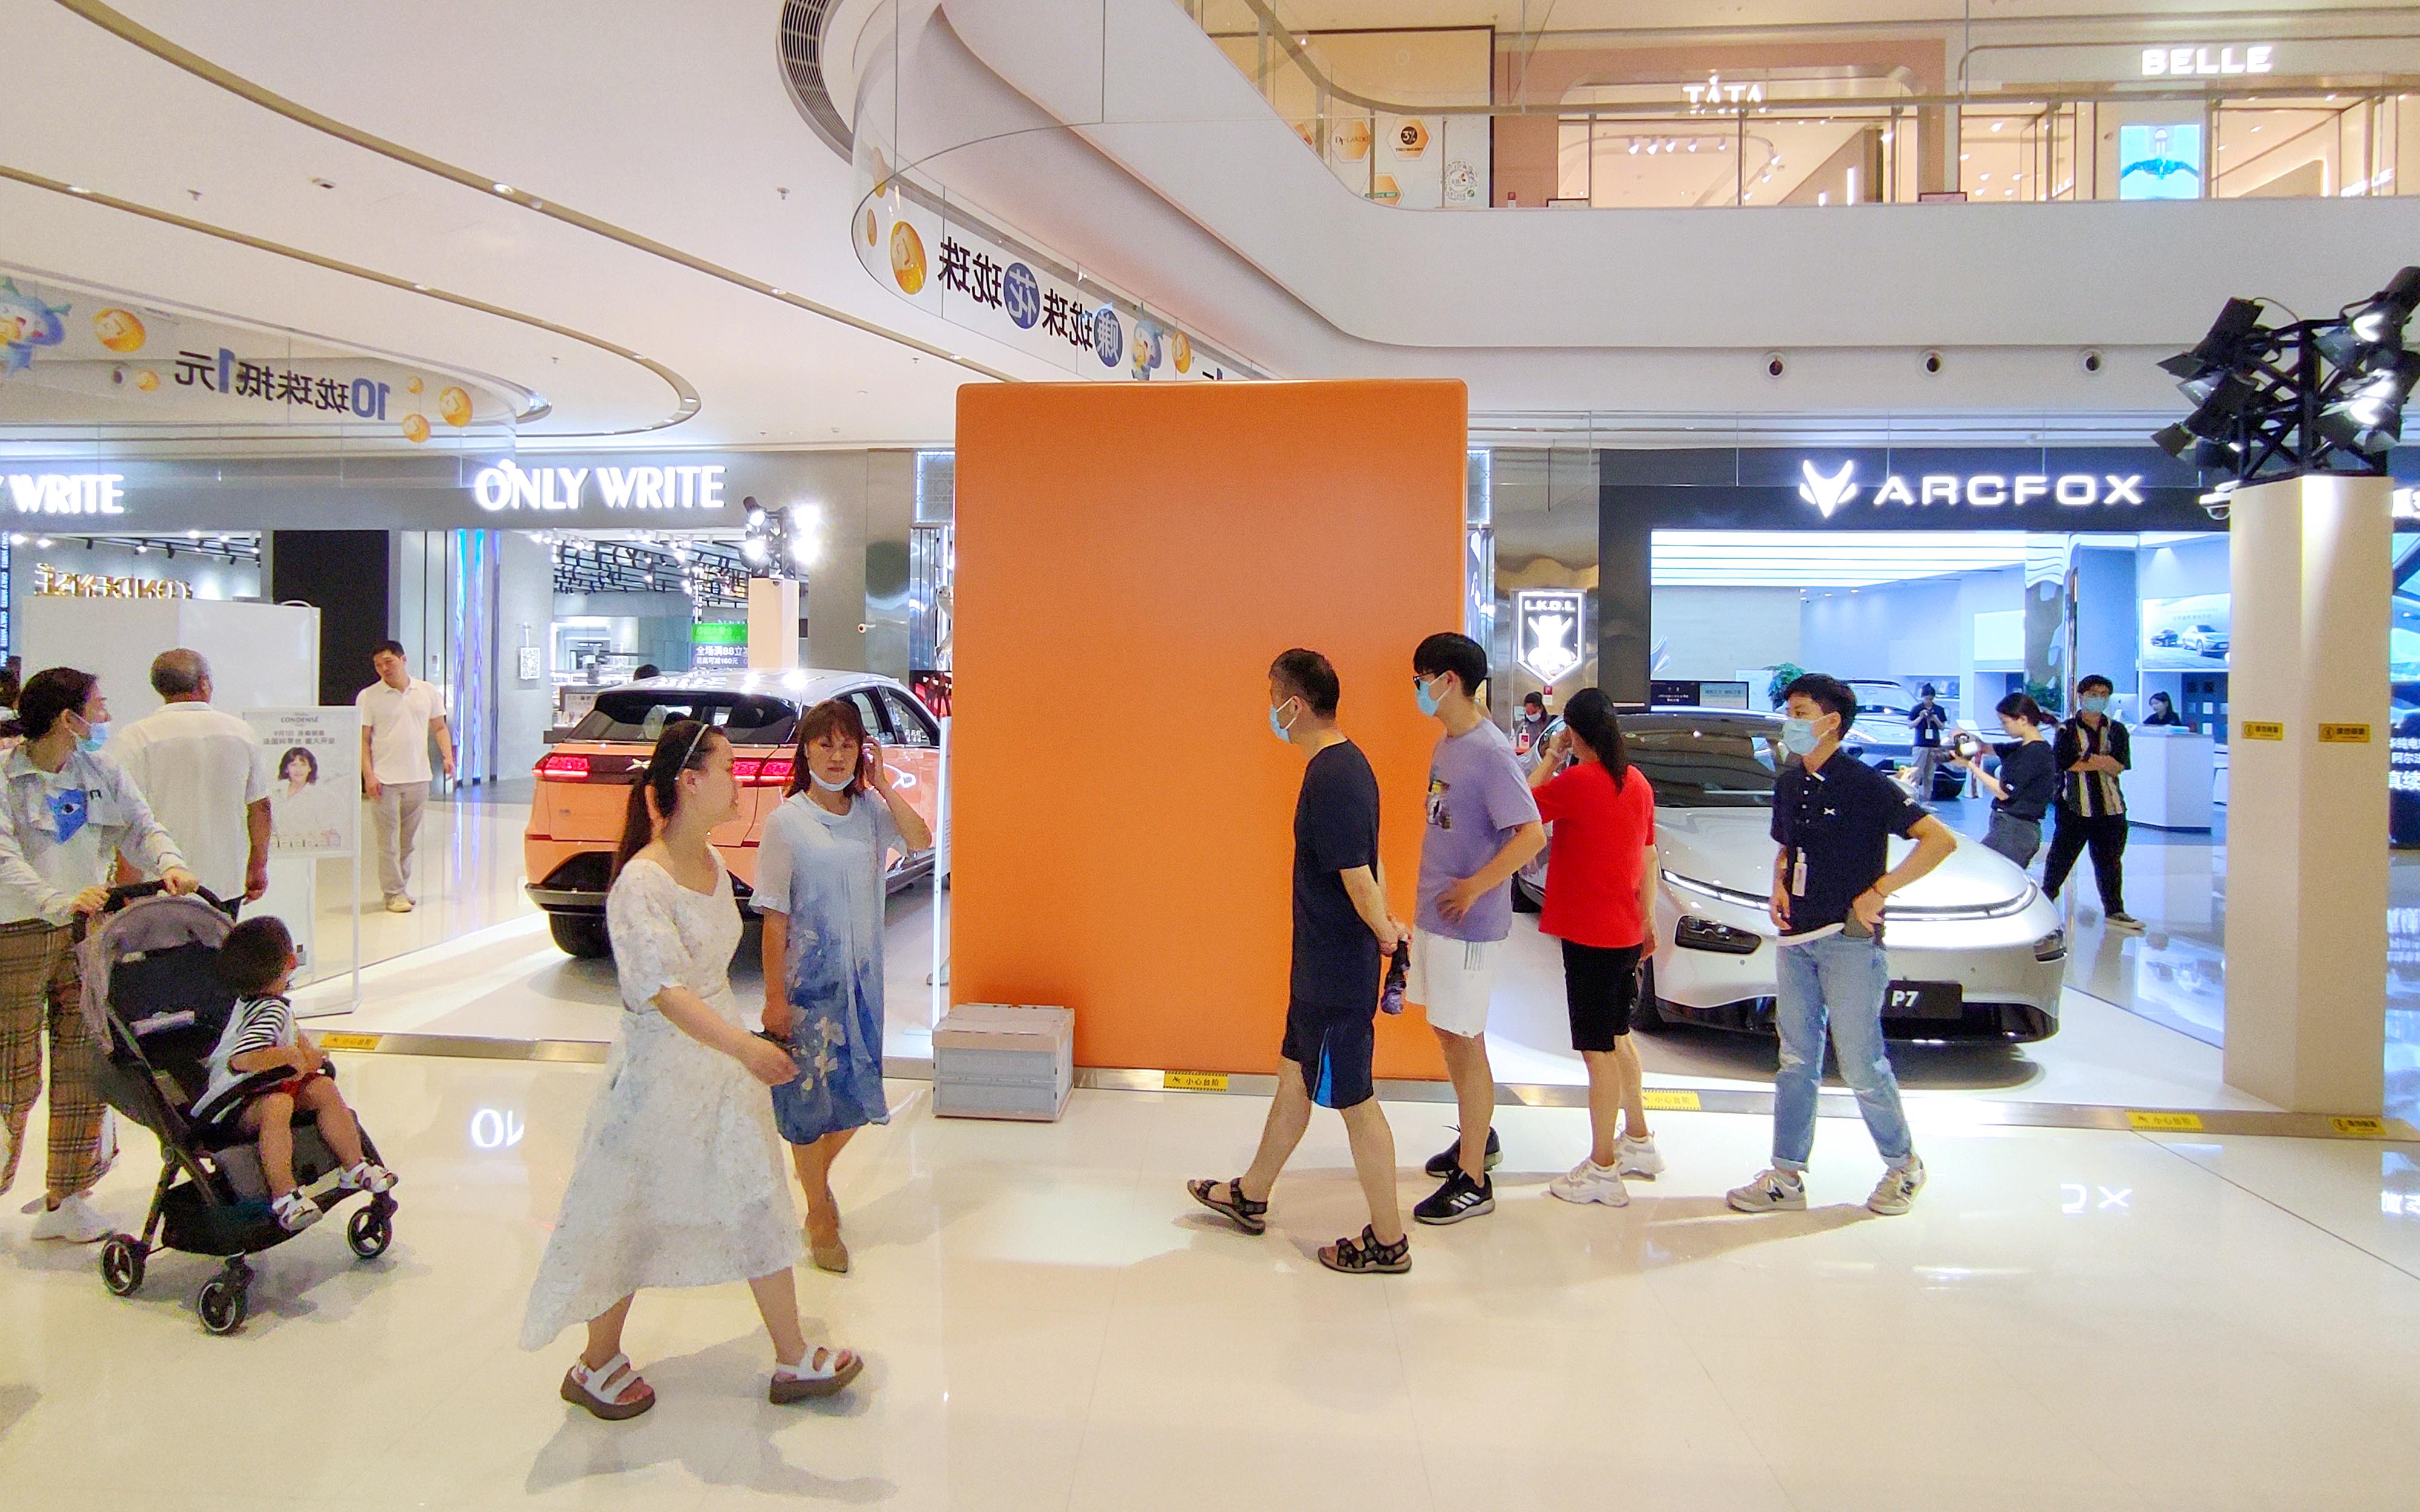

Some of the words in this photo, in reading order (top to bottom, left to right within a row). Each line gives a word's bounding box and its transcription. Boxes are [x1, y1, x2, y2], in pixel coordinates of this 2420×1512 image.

[2142, 45, 2272, 75] BELLE
[13, 474, 125, 513] WRITE
[475, 464, 589, 510] ONLY
[597, 465, 725, 509] WRITE
[1873, 475, 2144, 506] ARCFOX
[1891, 990, 1919, 1008] P7
[1185, 1077, 1220, 1087] 小心台阶
